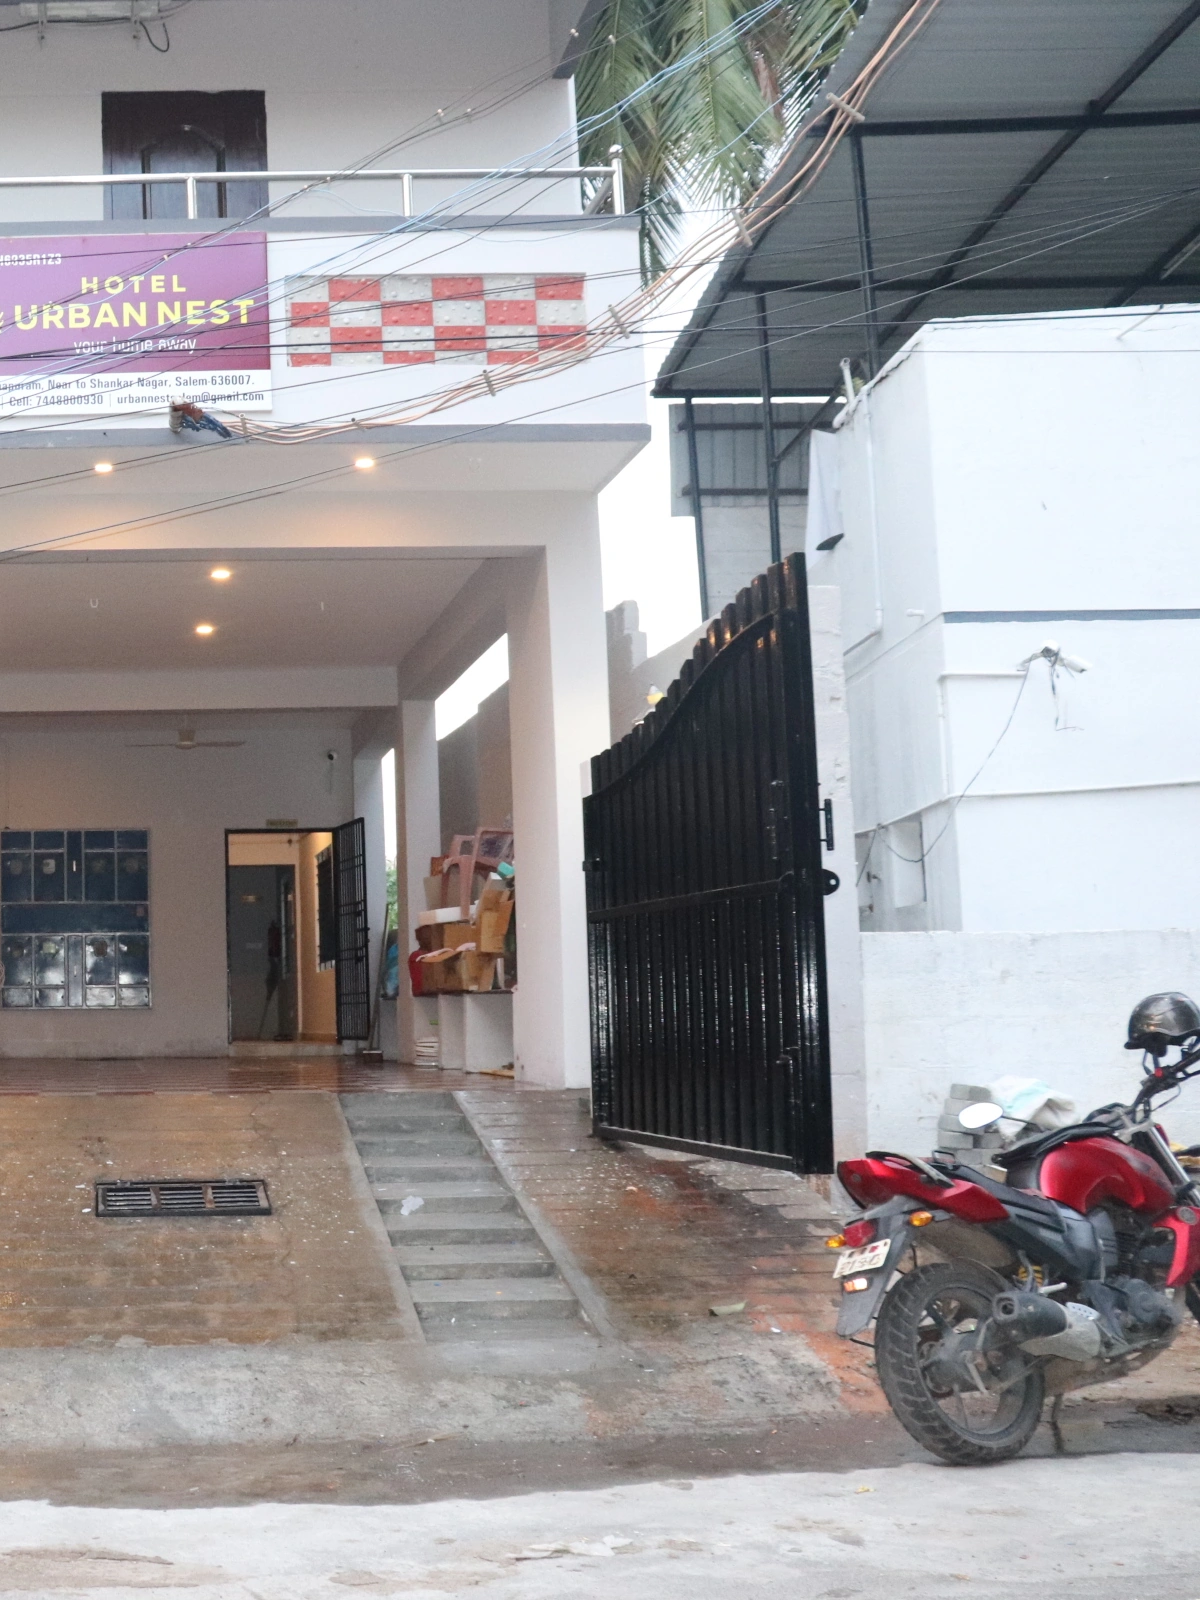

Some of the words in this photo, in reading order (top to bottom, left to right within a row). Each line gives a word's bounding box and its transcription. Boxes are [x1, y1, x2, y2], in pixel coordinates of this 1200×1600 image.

[81, 274, 187, 295] HOTEL
[14, 302, 147, 331] URBAN
[157, 299, 254, 326] NEST
[74, 340, 107, 354] your
[112, 336, 153, 352] home
[158, 338, 196, 355] away
[48, 379, 72, 390] Near
[76, 379, 86, 389] to
[90, 378, 133, 389] Shankar
[137, 377, 172, 390] Nagar,
[9, 396, 32, 407] Cell:
[117, 391, 264, 405] urbannestlem@gmail.com
